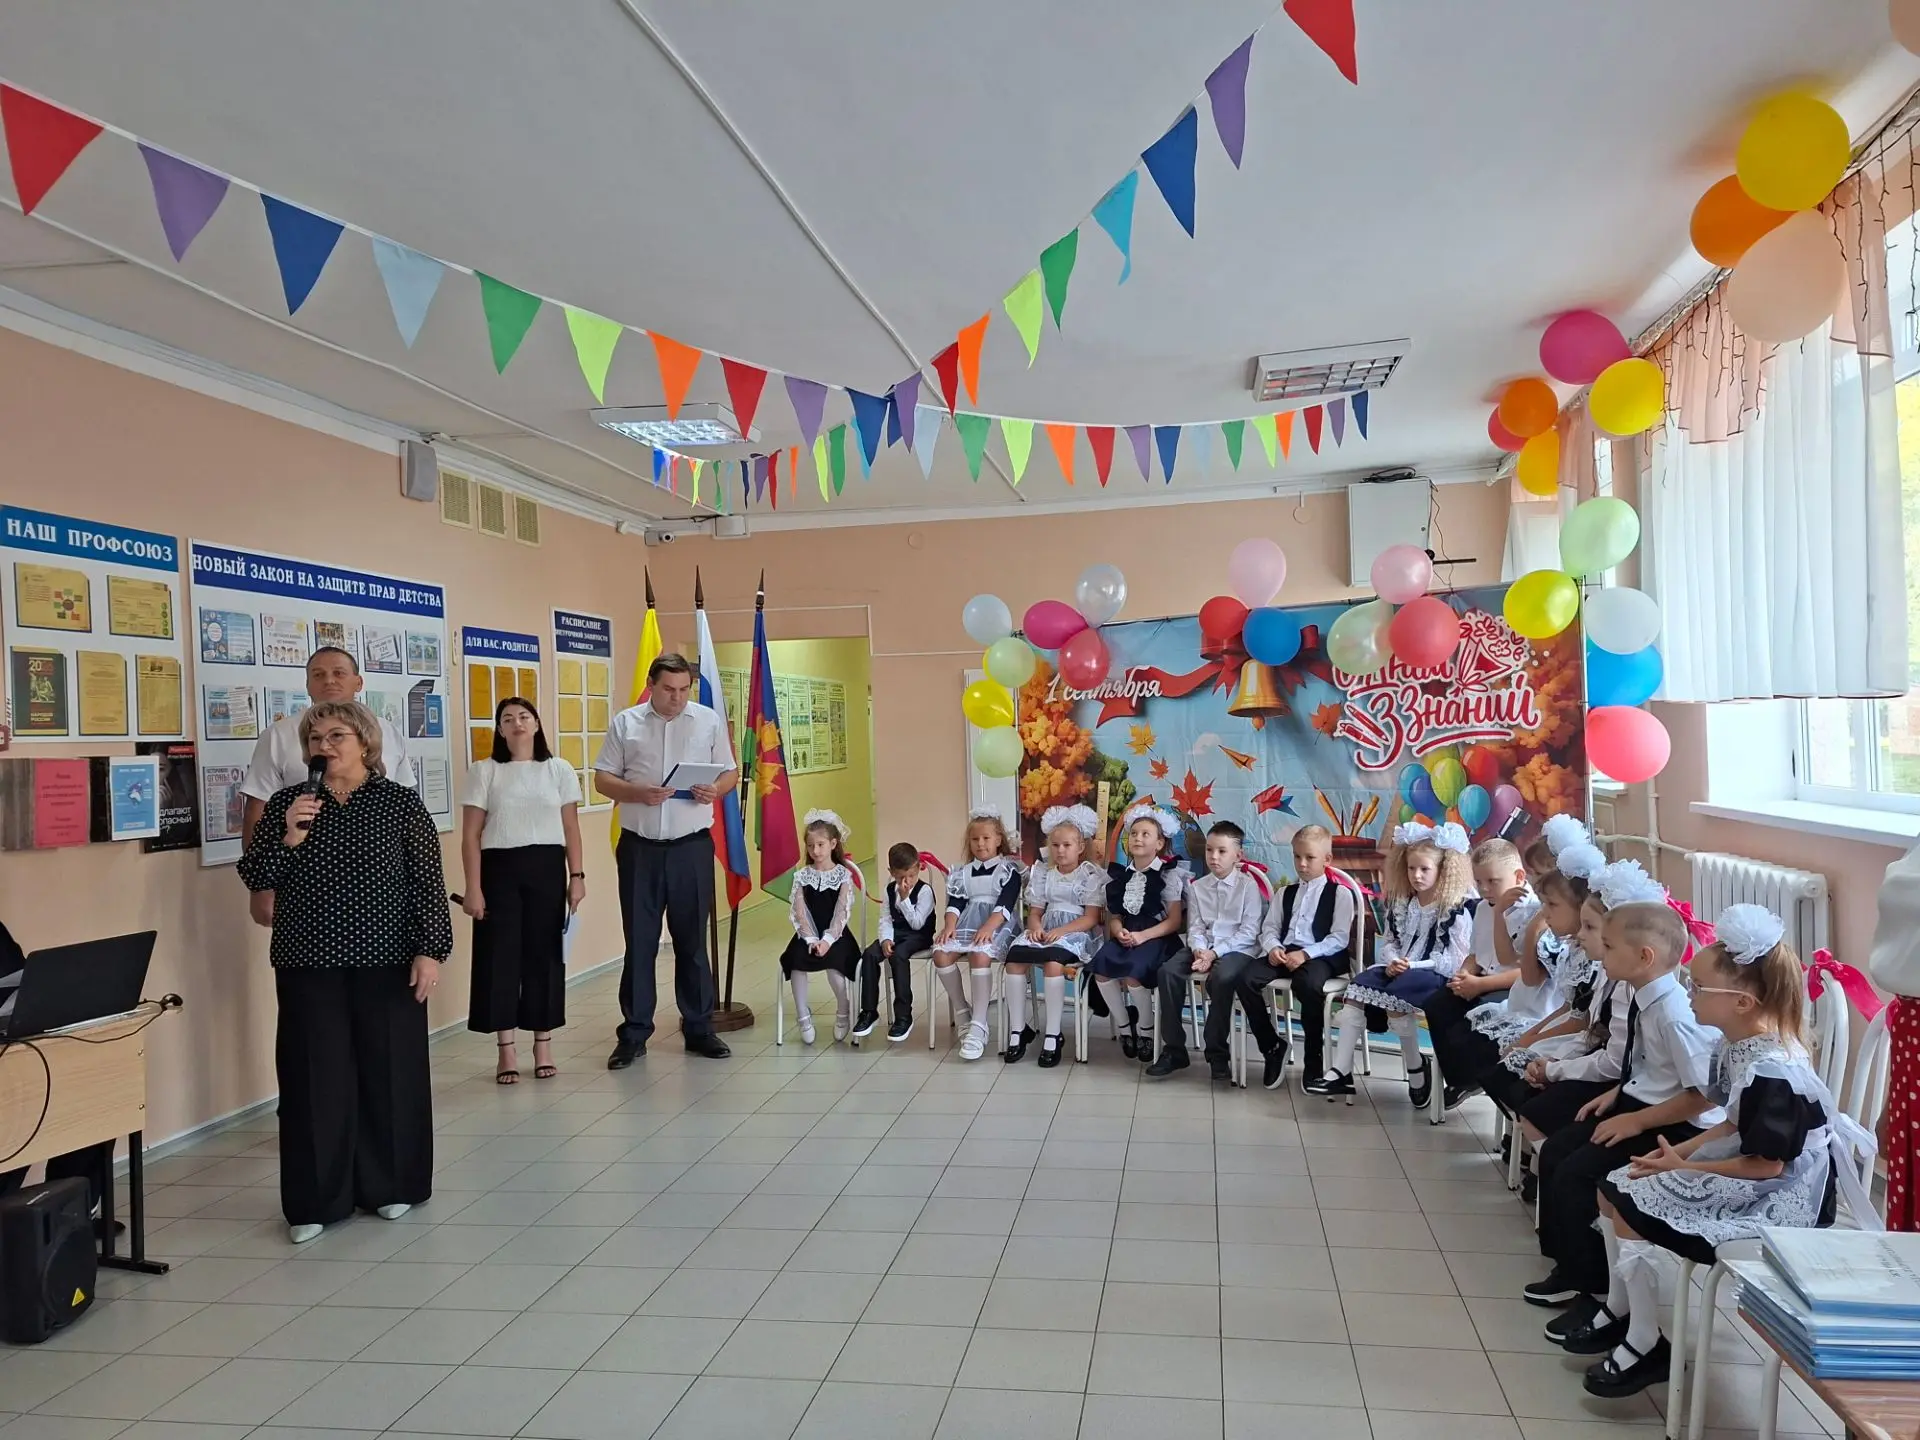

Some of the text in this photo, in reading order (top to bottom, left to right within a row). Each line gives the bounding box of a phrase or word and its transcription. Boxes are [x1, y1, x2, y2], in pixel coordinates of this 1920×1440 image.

[7, 518, 173, 562] НАШ ПРОФСОЮЗ
[192, 553, 442, 608] НОВЫЙ ЗАКОН НА ЗАЩИТЕ ПРАВ ДЕТСТВА
[561, 616, 602, 630] РАСПИСАНИЕ
[465, 636, 482, 648] ДЛЯ
[502, 641, 538, 654] РОДИТЕЛИ
[1044, 672, 1061, 704] 1
